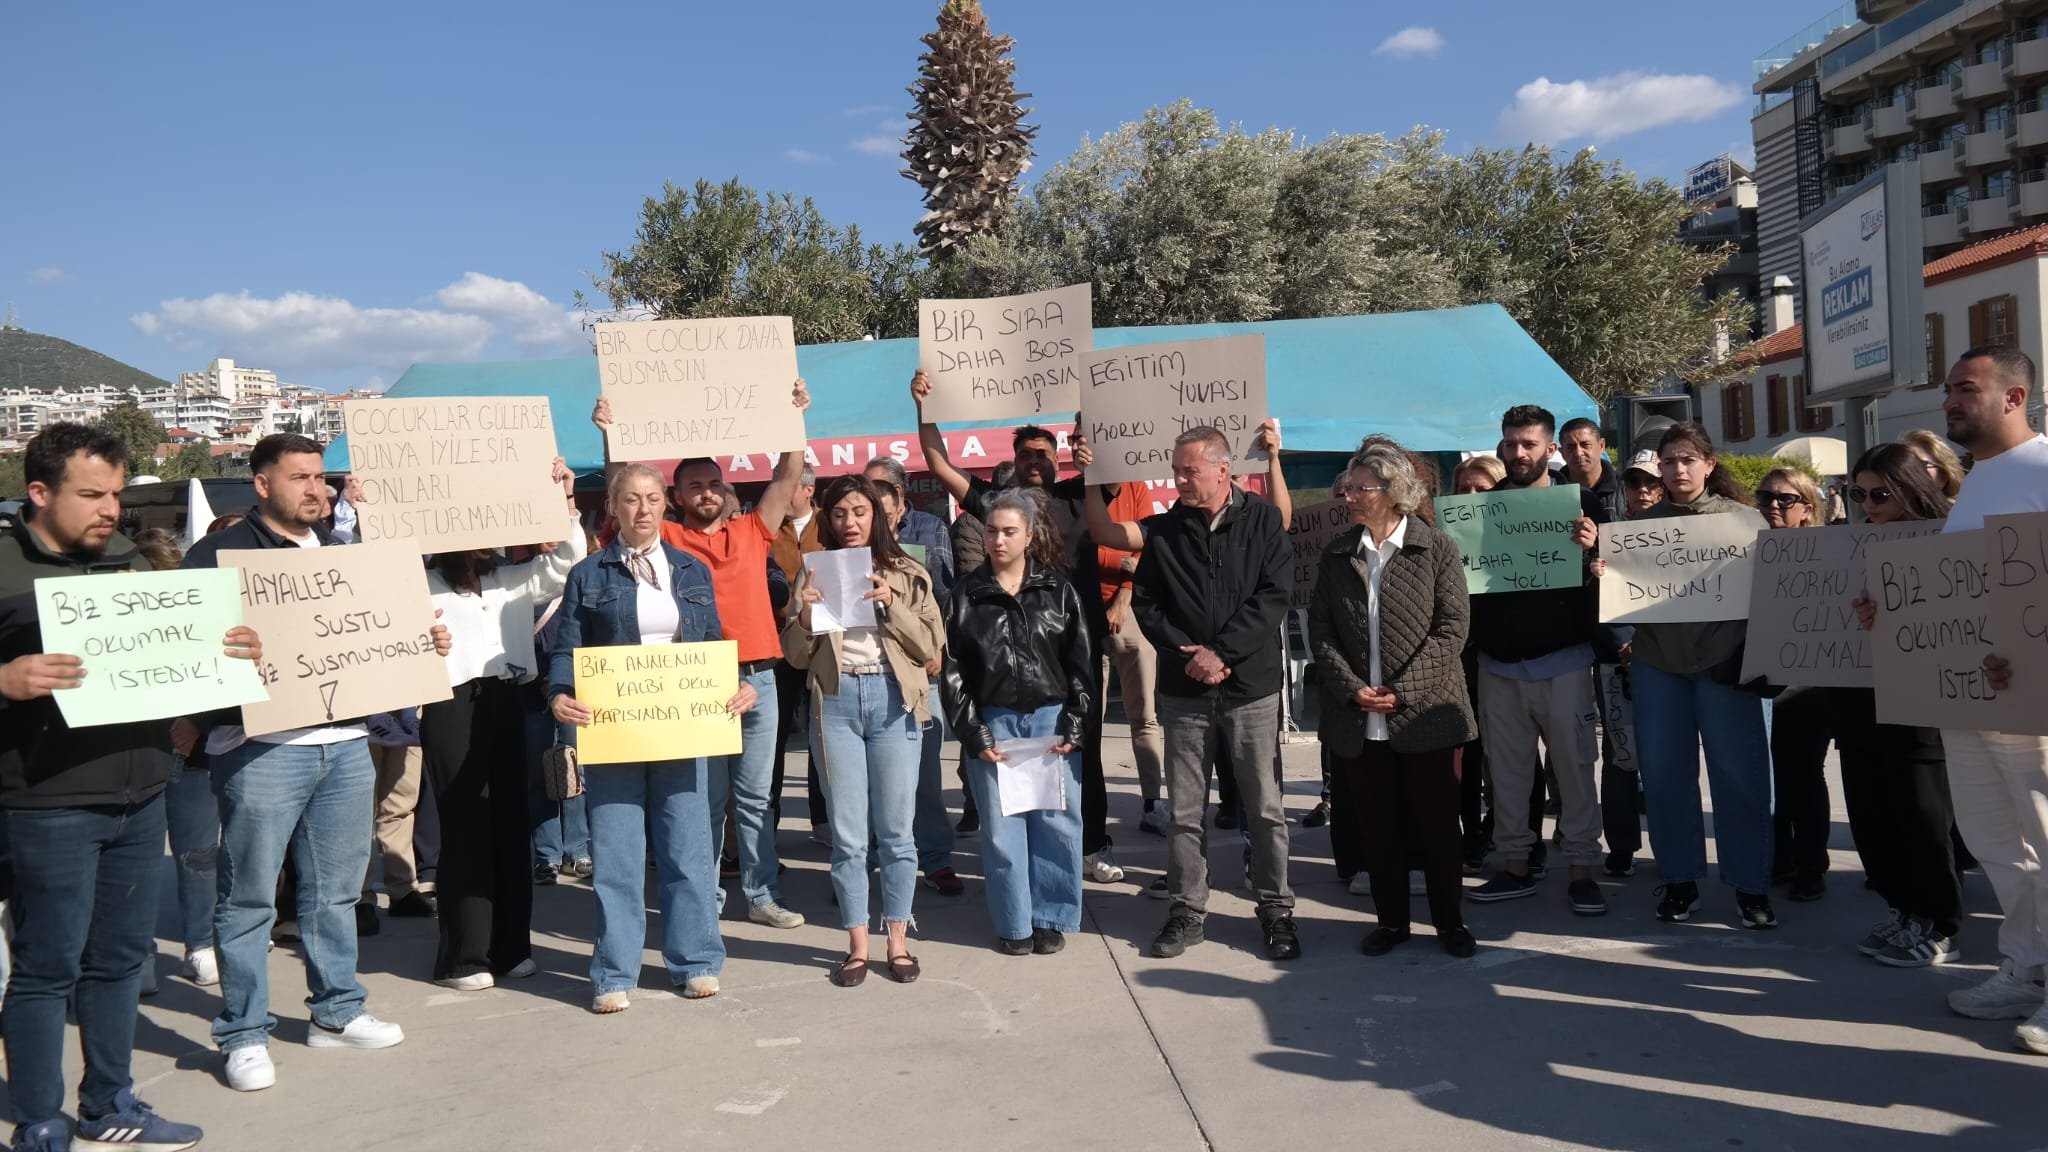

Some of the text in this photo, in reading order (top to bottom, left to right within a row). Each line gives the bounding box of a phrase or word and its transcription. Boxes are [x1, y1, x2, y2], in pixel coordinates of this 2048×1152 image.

[1829, 266, 1838, 281] Bu
[1824, 274, 1869, 319] REKLAM
[998, 301, 1063, 336] SIRA
[1827, 316, 1869, 343] Verebilirsiniz
[737, 324, 784, 350] DAHA
[607, 359, 706, 386] SUSMASIN
[937, 349, 1005, 373] DAHA
[972, 366, 1081, 399] KALMASIN
[1170, 380, 1247, 406] YUVASI
[1092, 420, 1155, 444] KORKU
[351, 440, 421, 472] DÜNYA
[361, 474, 451, 506] ONLARI
[1526, 550, 1567, 566] YER
[1656, 544, 1748, 569] ÇIĞLIKLARI
[1761, 535, 1824, 564] OKUL
[241, 567, 354, 607] HAYALLER
[1776, 571, 1848, 599] KORKU
[111, 588, 203, 616] SADECE
[314, 611, 391, 637] SUSTU
[1896, 615, 1994, 652] OKUMAK
[85, 623, 205, 656] OKUMAK
[297, 633, 436, 679] SUSMUYORUZ
[626, 649, 707, 672] ANNENİN
[678, 677, 720, 690] OKUL
[593, 705, 680, 726] KAPISINDA
